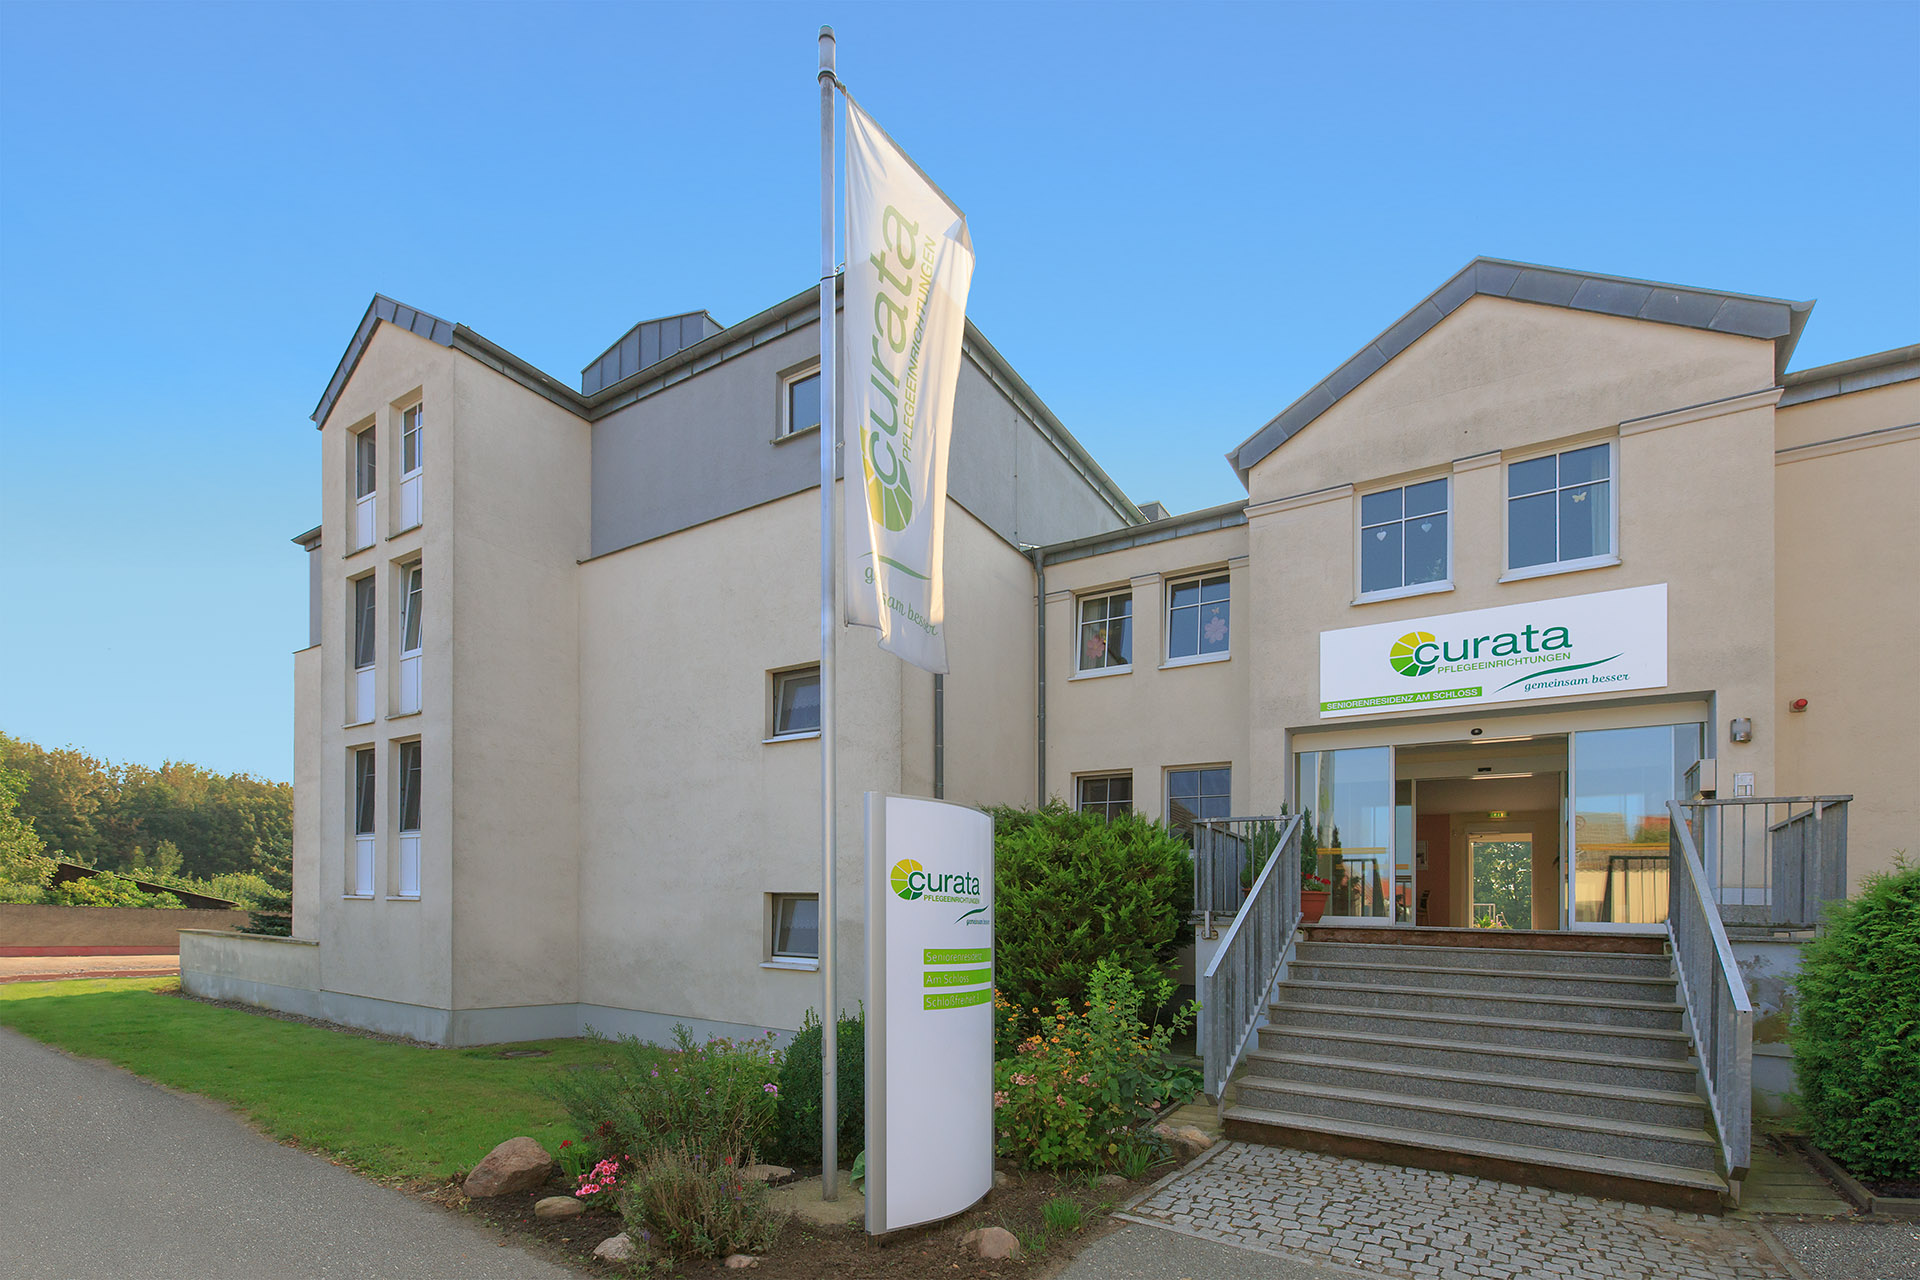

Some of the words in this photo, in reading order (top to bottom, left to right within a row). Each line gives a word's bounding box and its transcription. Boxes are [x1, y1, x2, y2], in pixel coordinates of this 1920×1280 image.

[869, 205, 919, 485] curata
[903, 235, 937, 463] PFLEGEEINRICHTUNGEN
[1414, 624, 1573, 666] curata
[1437, 652, 1571, 674] PFLEGEEINRICHTUNGEN
[1524, 677, 1589, 692] gemeinsam
[1591, 672, 1630, 684] besser
[1326, 695, 1414, 710] SENIORENRESIDENZ
[1416, 693, 1431, 703] AM
[1433, 688, 1478, 700] SCHLOSS
[908, 871, 980, 896] curata
[926, 976, 942, 985] Am
[944, 972, 969, 984] Schloss
